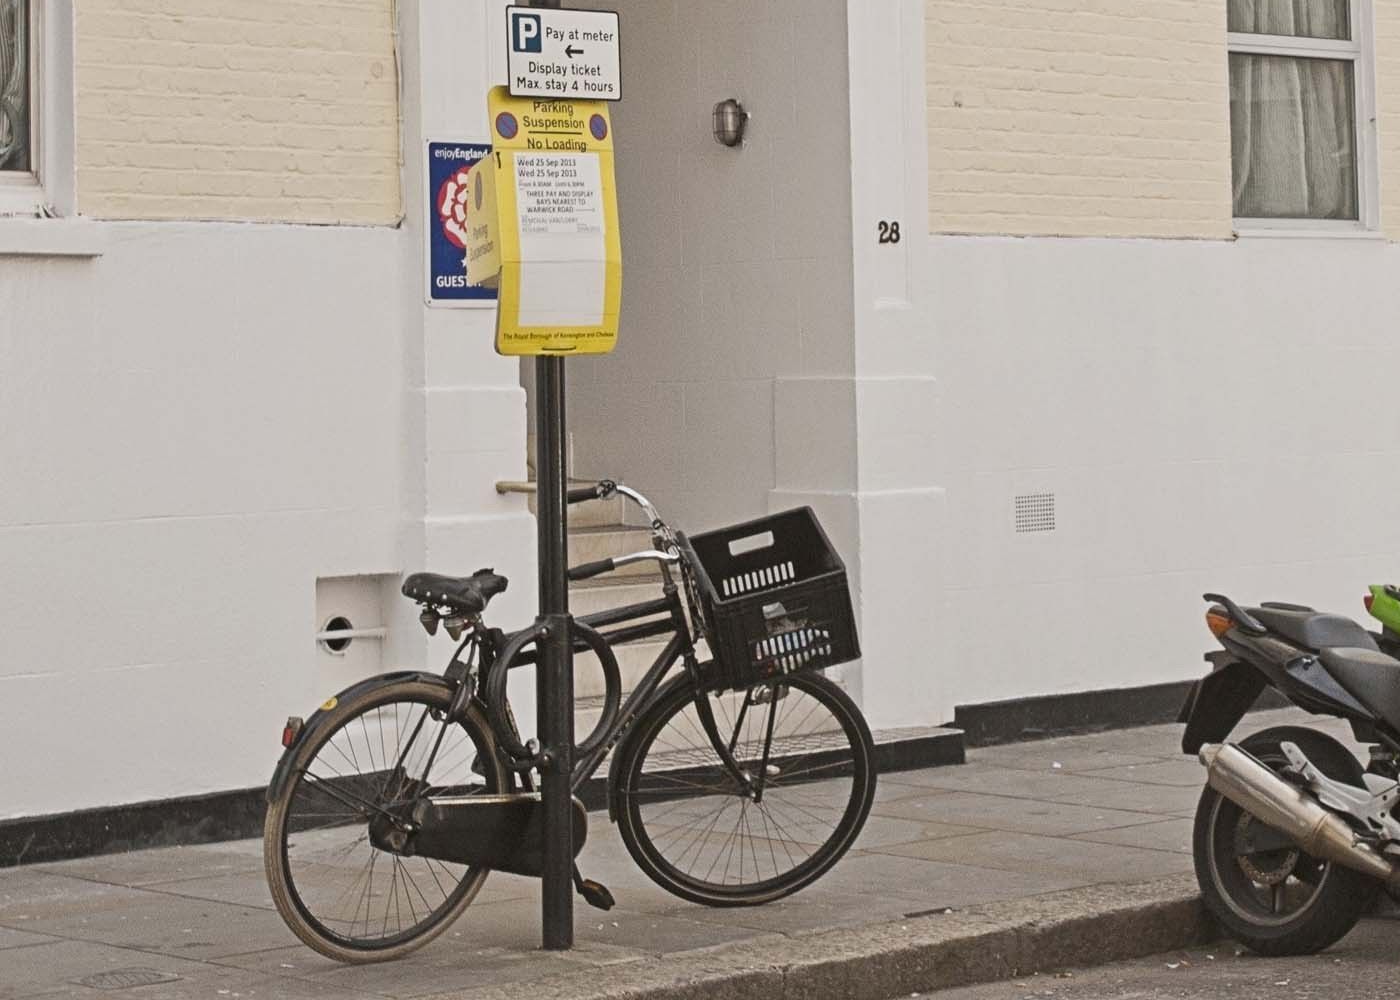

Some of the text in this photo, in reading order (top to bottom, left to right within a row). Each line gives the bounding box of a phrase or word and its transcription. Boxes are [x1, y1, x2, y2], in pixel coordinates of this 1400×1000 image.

[519, 17, 537, 49] P
[545, 27, 613, 41] Pay at meter
[529, 61, 601, 76] Display ticket
[545, 79, 567, 92] stay
[571, 81, 578, 91] 4
[584, 80, 613, 92] hours
[533, 101, 573, 116] Parking
[523, 115, 585, 130] Suspension
[527, 138, 587, 152] No Loading
[546, 159, 558, 167] Sep
[518, 169, 577, 178] Wed 25 Sep 2013
[878, 220, 900, 244] 28
[436, 275, 467, 288] GUES
